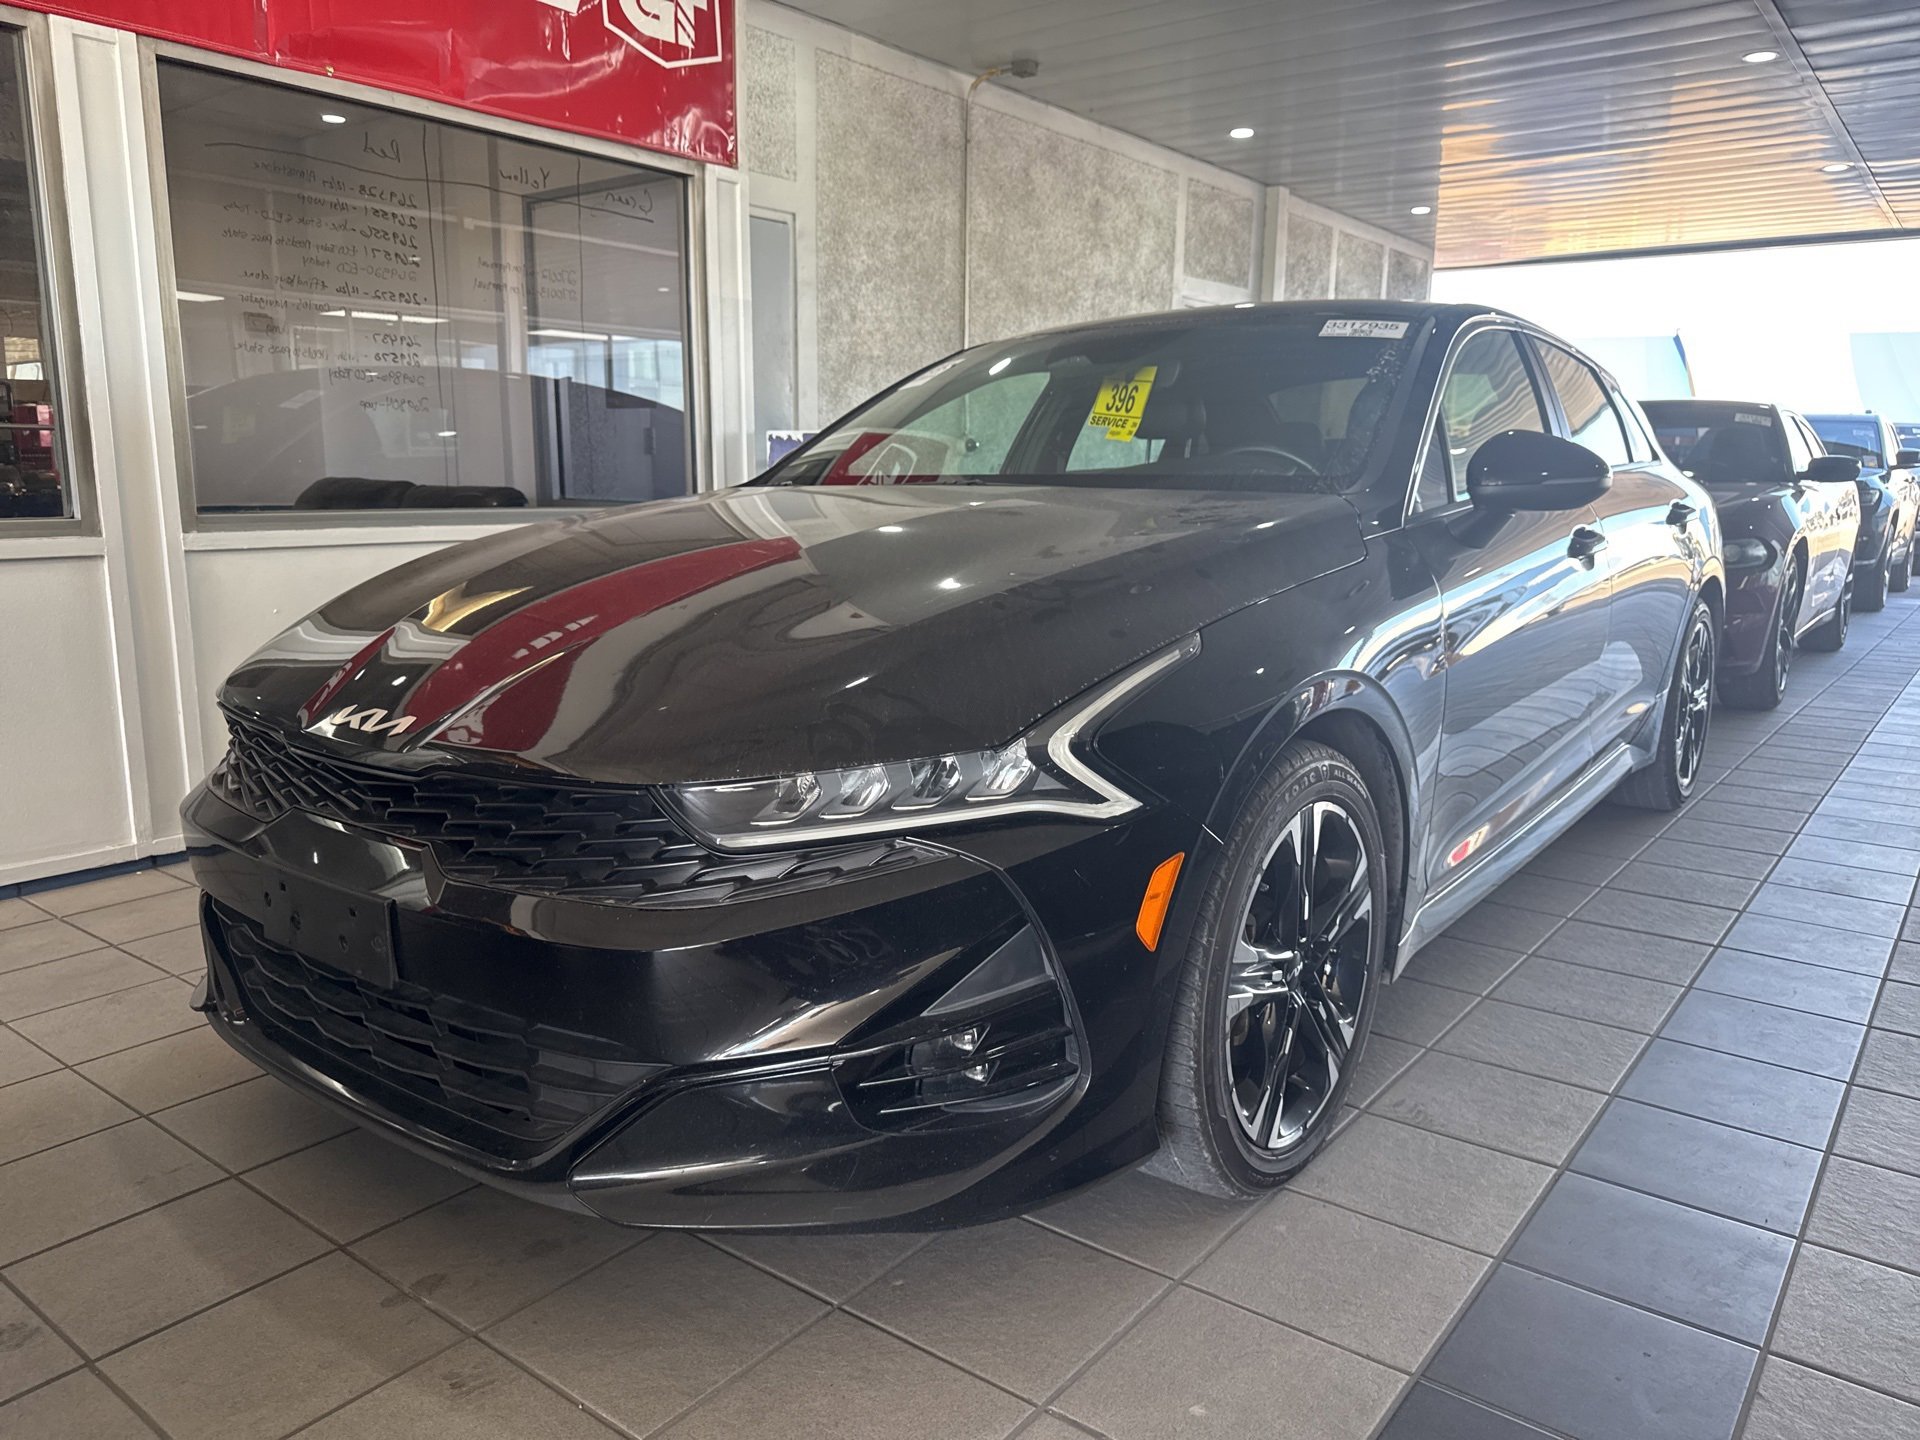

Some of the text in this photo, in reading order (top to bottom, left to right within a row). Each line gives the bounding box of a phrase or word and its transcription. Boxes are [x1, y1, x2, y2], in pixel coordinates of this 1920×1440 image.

[1105, 384, 1139, 414] 396
[1090, 415, 1129, 428] SERVICE
[330, 704, 418, 737] KIA
